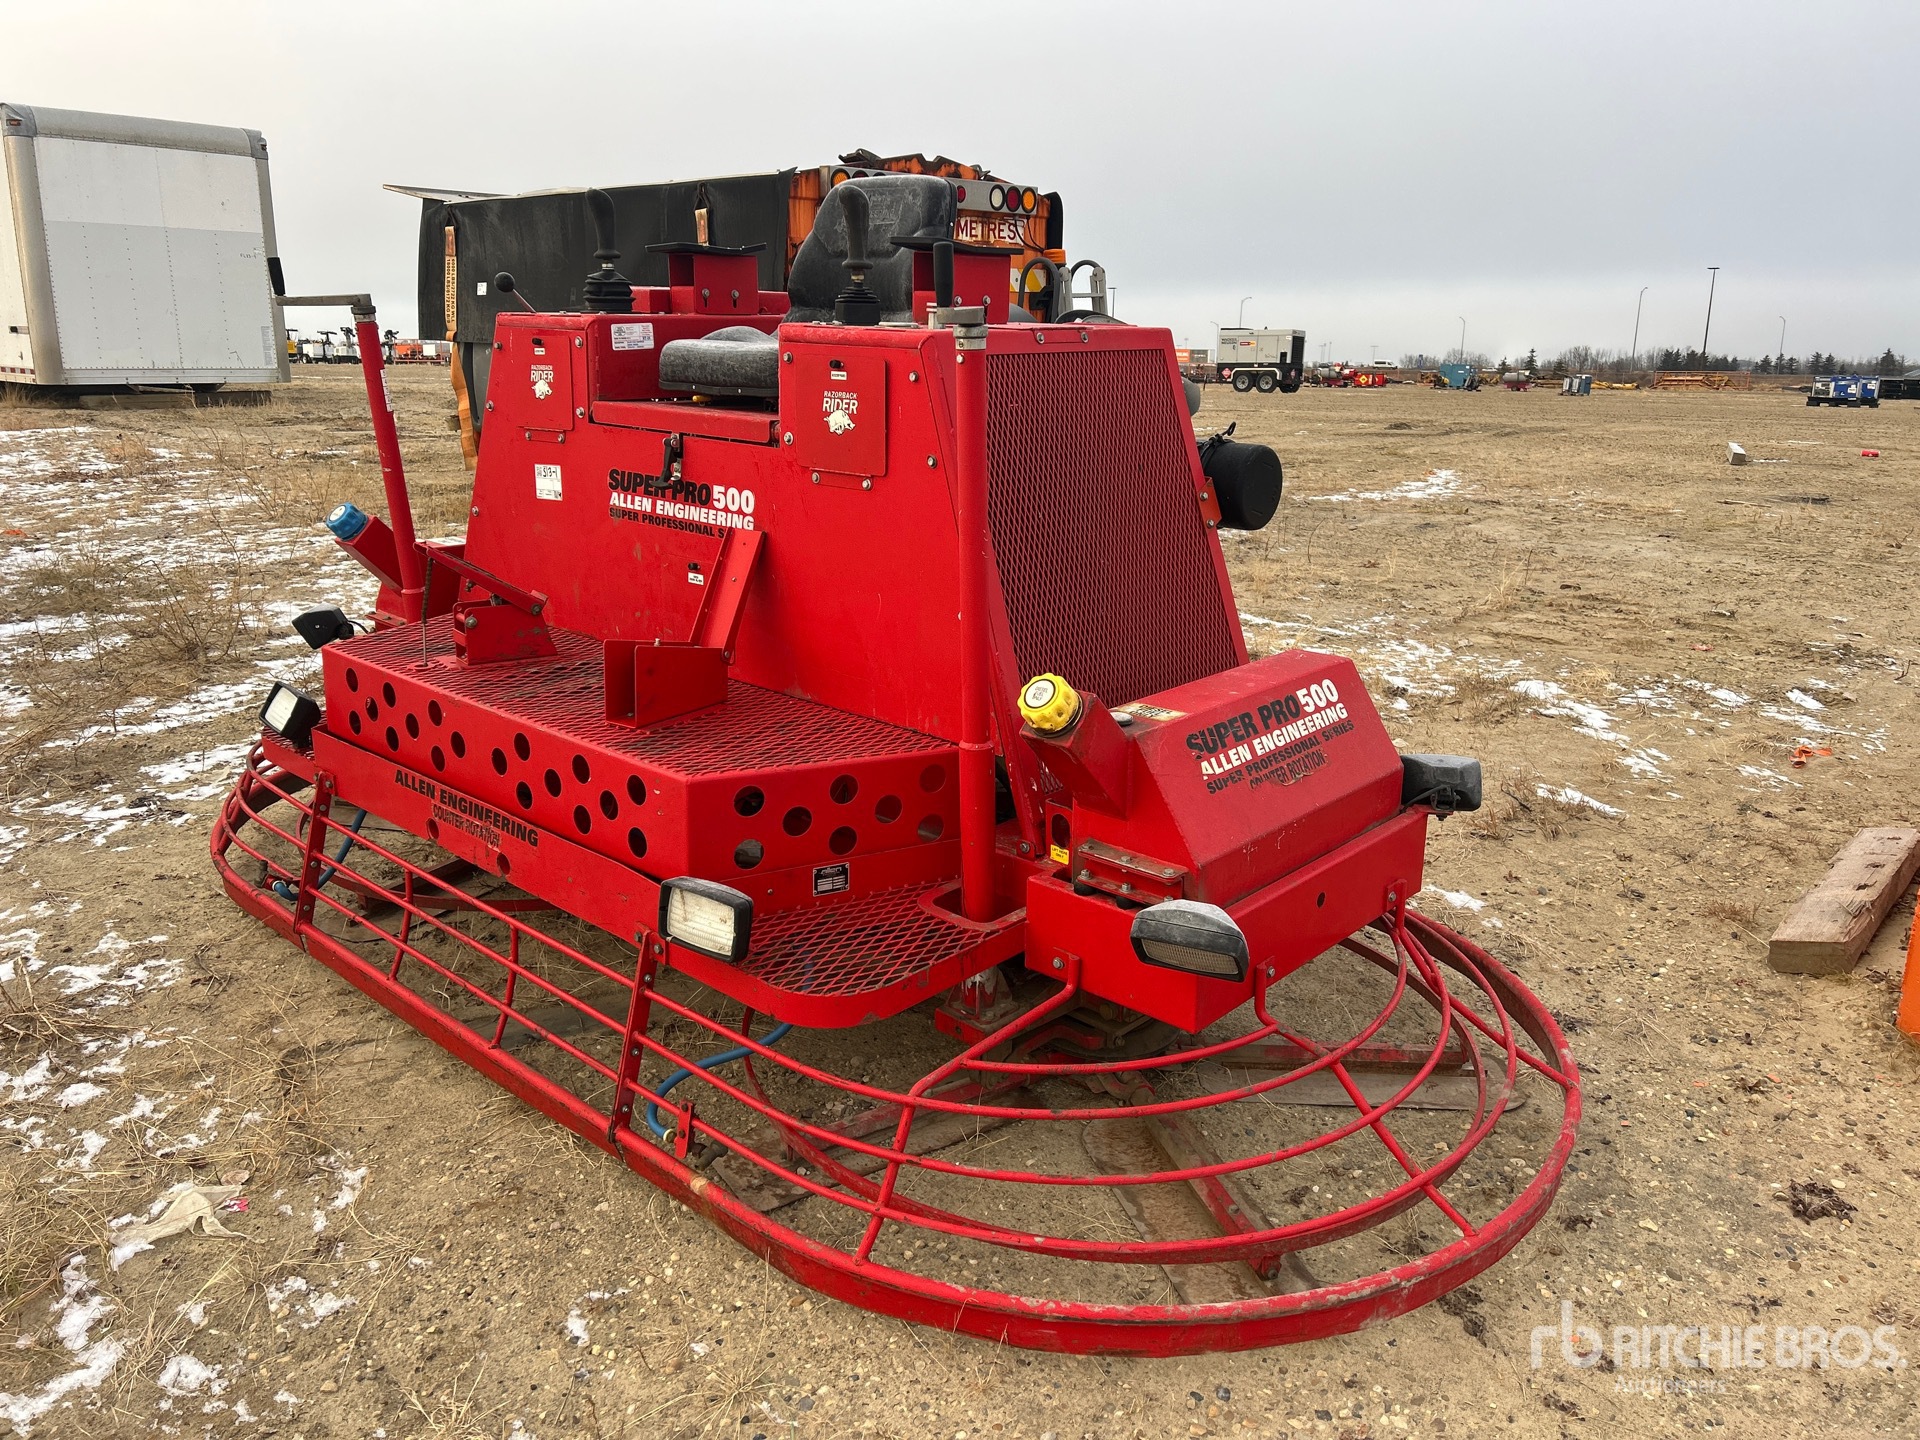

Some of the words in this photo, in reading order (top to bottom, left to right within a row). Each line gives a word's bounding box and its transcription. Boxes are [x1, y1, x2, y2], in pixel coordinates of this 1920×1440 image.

[956, 219, 1016, 241] METRES
[531, 370, 553, 382] RIDER
[822, 398, 858, 414] RIDER
[824, 391, 857, 399] RAZORBACK
[610, 492, 652, 512] ALLEN
[656, 500, 754, 531] ENGINEERING
[610, 508, 639, 522] SUPER
[642, 514, 715, 537] PROFESSIONAL
[1186, 712, 1258, 759] SUPER
[1201, 743, 1252, 779] ALLEN
[1252, 702, 1348, 756] ENGINEERING
[1207, 770, 1245, 794] SUPER
[1245, 736, 1322, 775] PROFESSIONAL
[1321, 720, 1354, 741] SERIES
[1286, 749, 1326, 778] ROTATION
[395, 769, 435, 799] ALLEN
[440, 788, 538, 847] ENGINEERING
